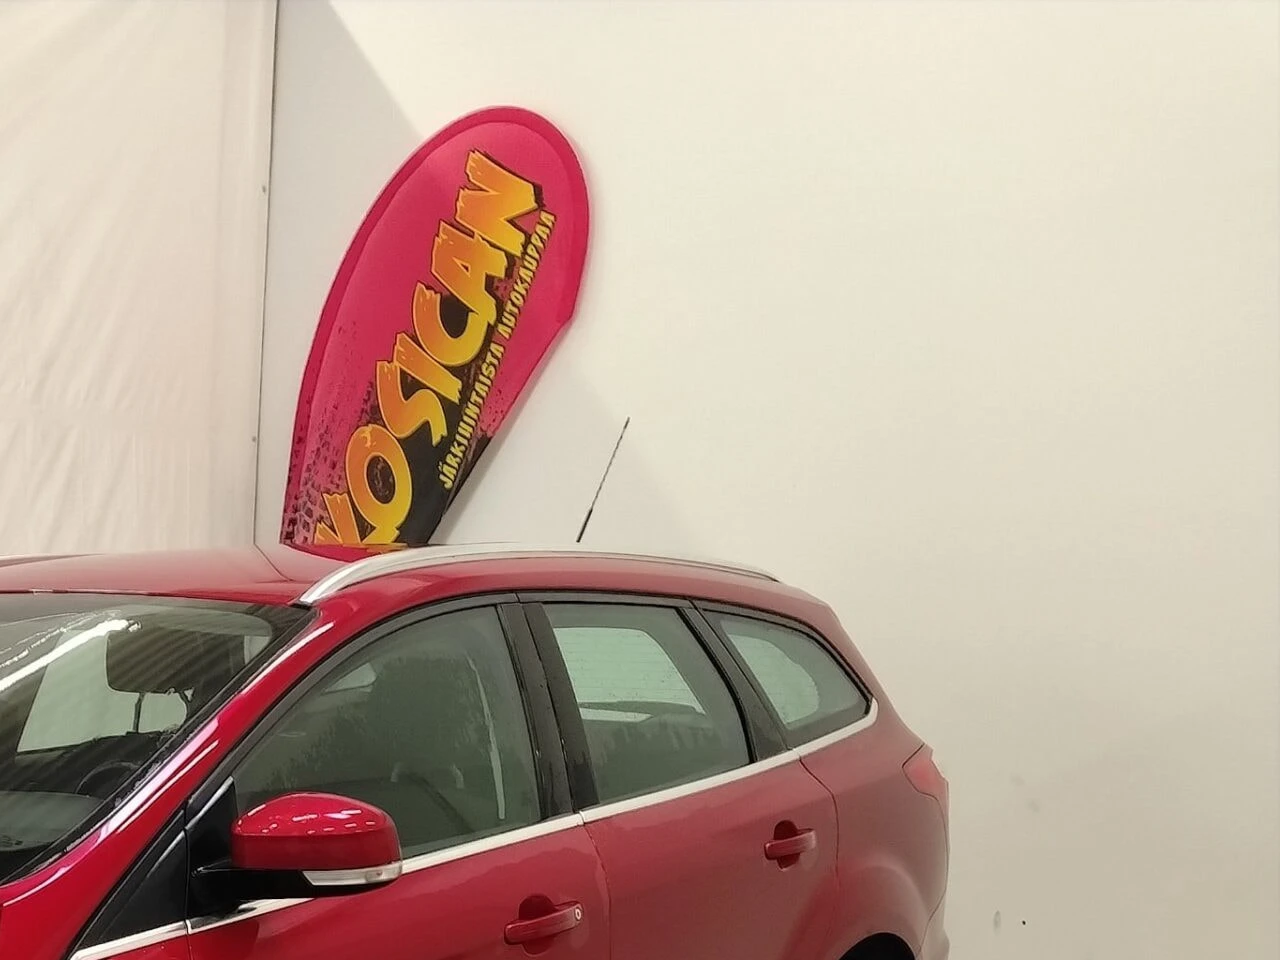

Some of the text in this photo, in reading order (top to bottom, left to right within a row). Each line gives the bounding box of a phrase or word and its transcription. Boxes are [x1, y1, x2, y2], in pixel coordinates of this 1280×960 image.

[313, 149, 538, 551] KOSICAN
[438, 211, 556, 489] JÄRKIHINTAISTA AUTOKAUPPAA
